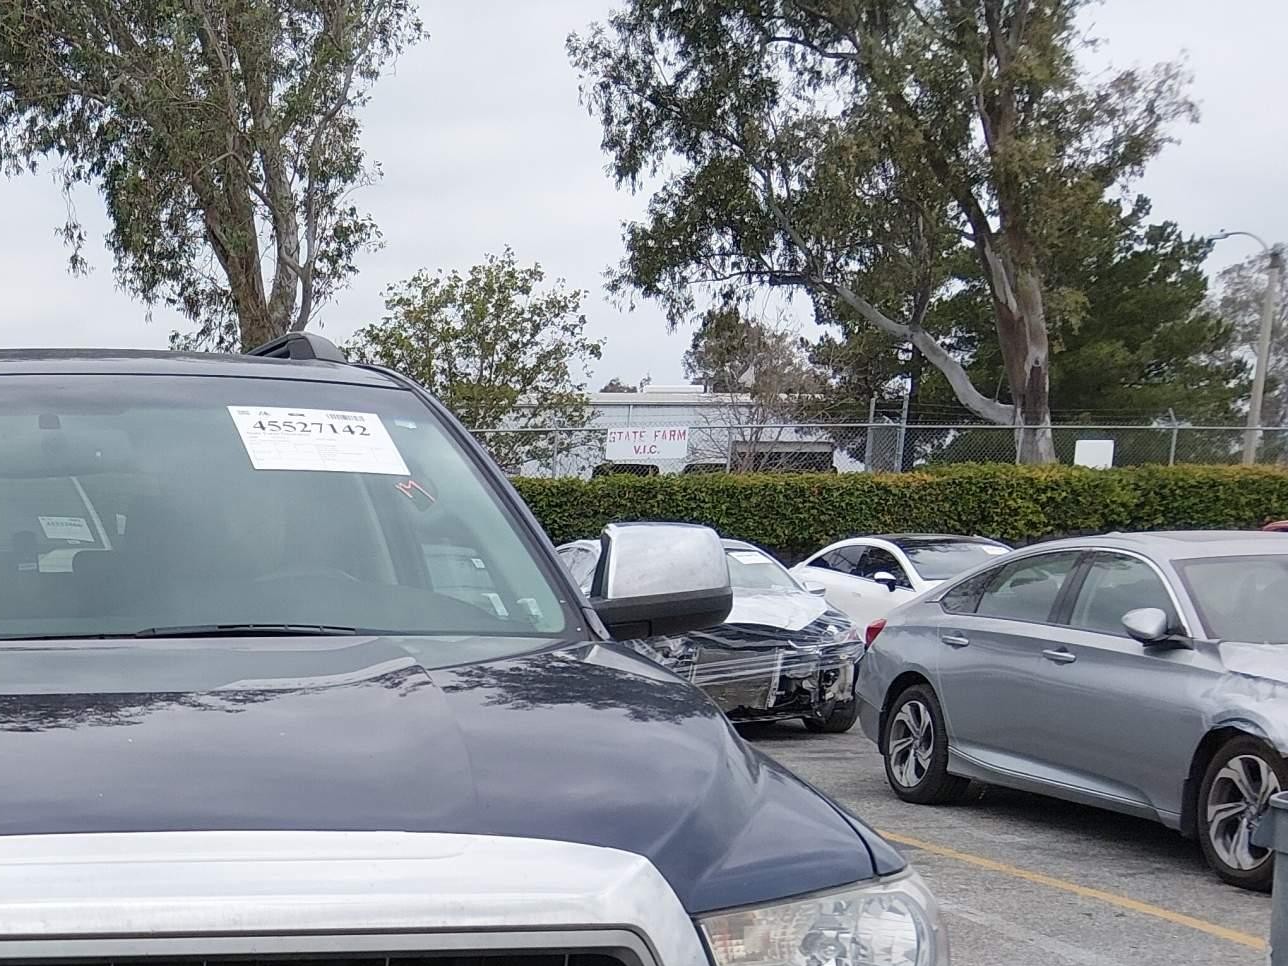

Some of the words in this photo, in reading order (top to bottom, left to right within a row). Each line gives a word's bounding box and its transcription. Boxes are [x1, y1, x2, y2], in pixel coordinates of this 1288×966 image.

[253, 420, 370, 436] 45527142
[609, 430, 646, 443] STATE
[654, 429, 686, 442] FARM
[633, 444, 660, 455] V.I.C.
